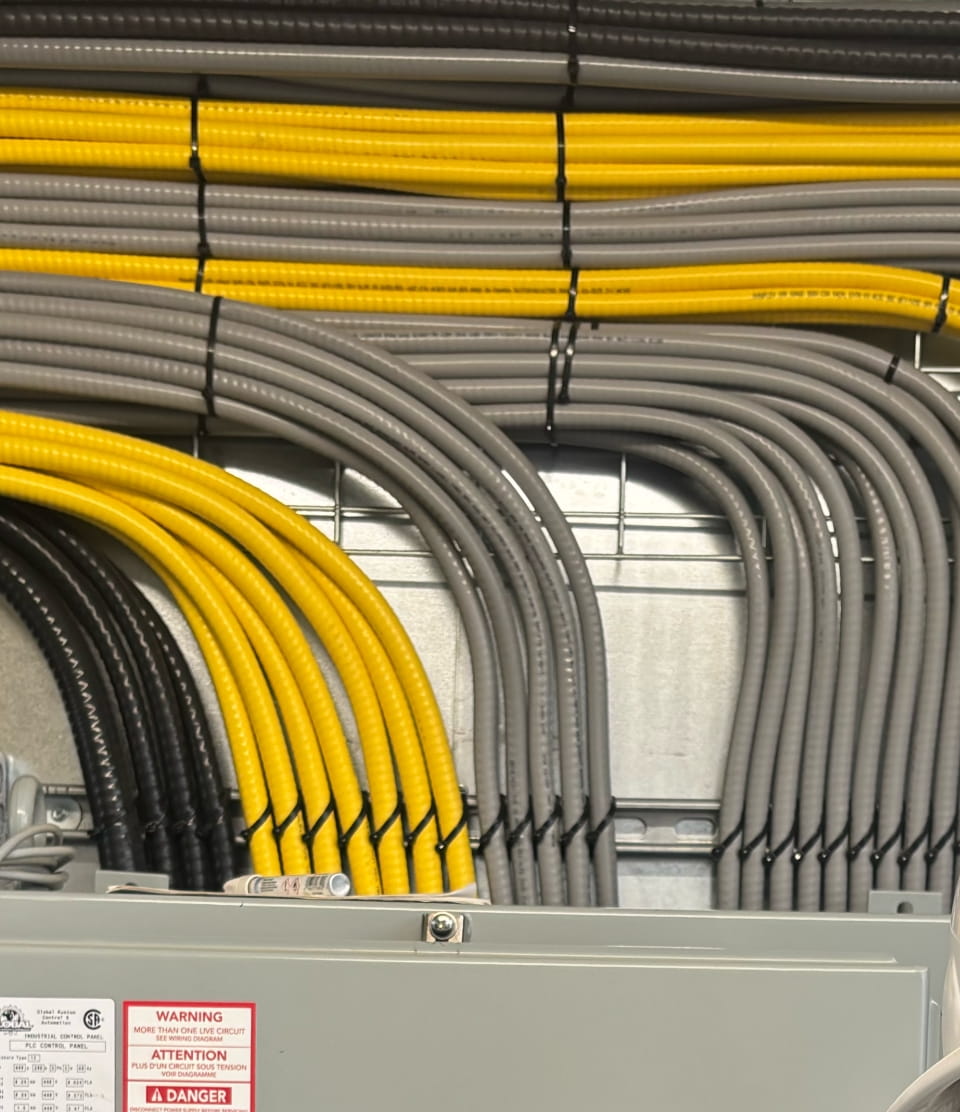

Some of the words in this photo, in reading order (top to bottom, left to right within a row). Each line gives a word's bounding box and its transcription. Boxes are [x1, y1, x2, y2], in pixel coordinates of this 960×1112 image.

[156, 1010, 224, 1022] WARNING
[134, 1026, 156, 1034] MORE
[158, 1026, 178, 1034] THAN
[151, 1050, 227, 1061] ATTENTION
[166, 1089, 226, 1103] DANGER
